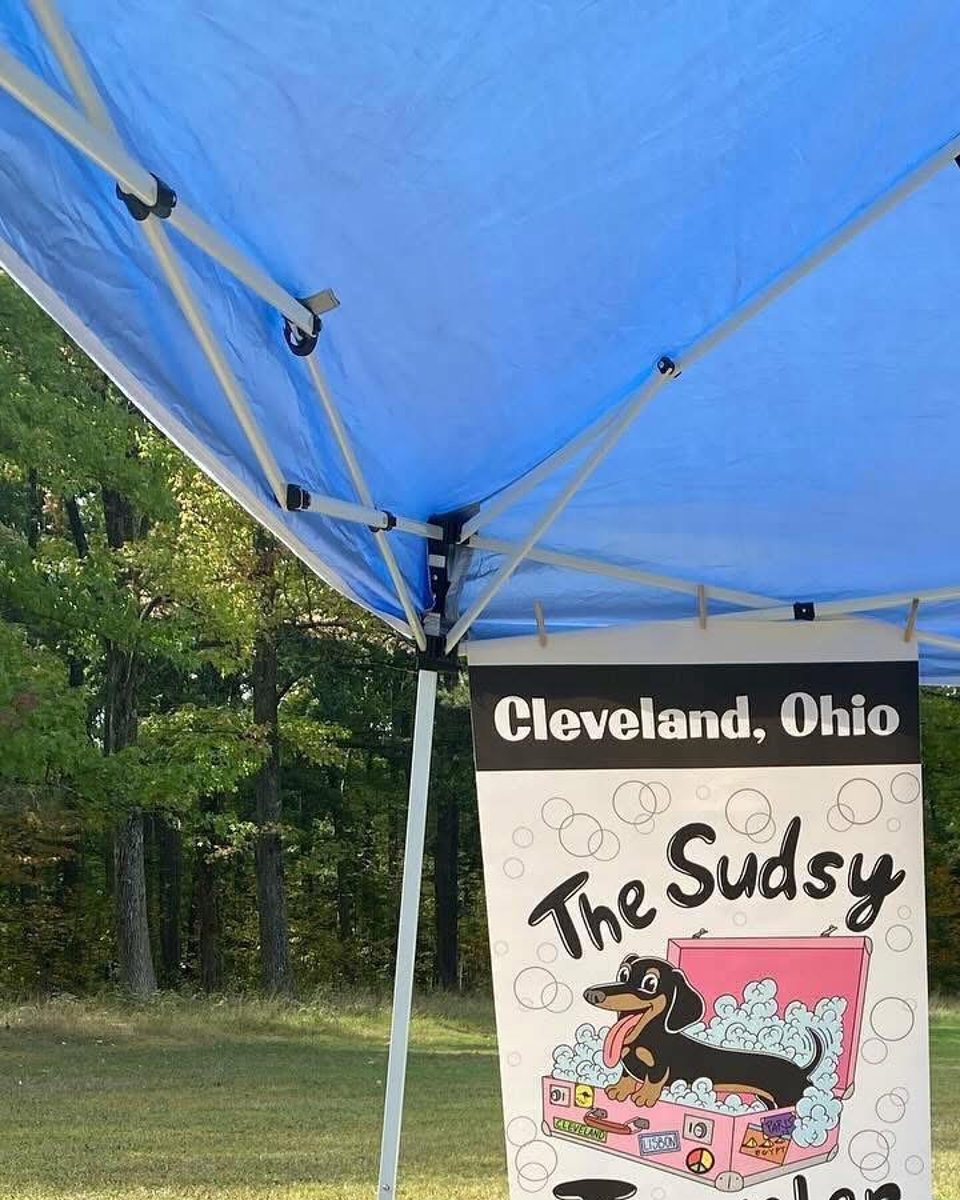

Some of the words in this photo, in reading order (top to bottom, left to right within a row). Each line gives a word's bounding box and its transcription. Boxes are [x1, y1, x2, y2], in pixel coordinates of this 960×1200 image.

[493, 696, 767, 745] Cleveland,
[780, 692, 900, 737] Ohio
[528, 871, 657, 960] The
[666, 816, 906, 933] Sudsy
[555, 1119, 605, 1140] CLEVELAND
